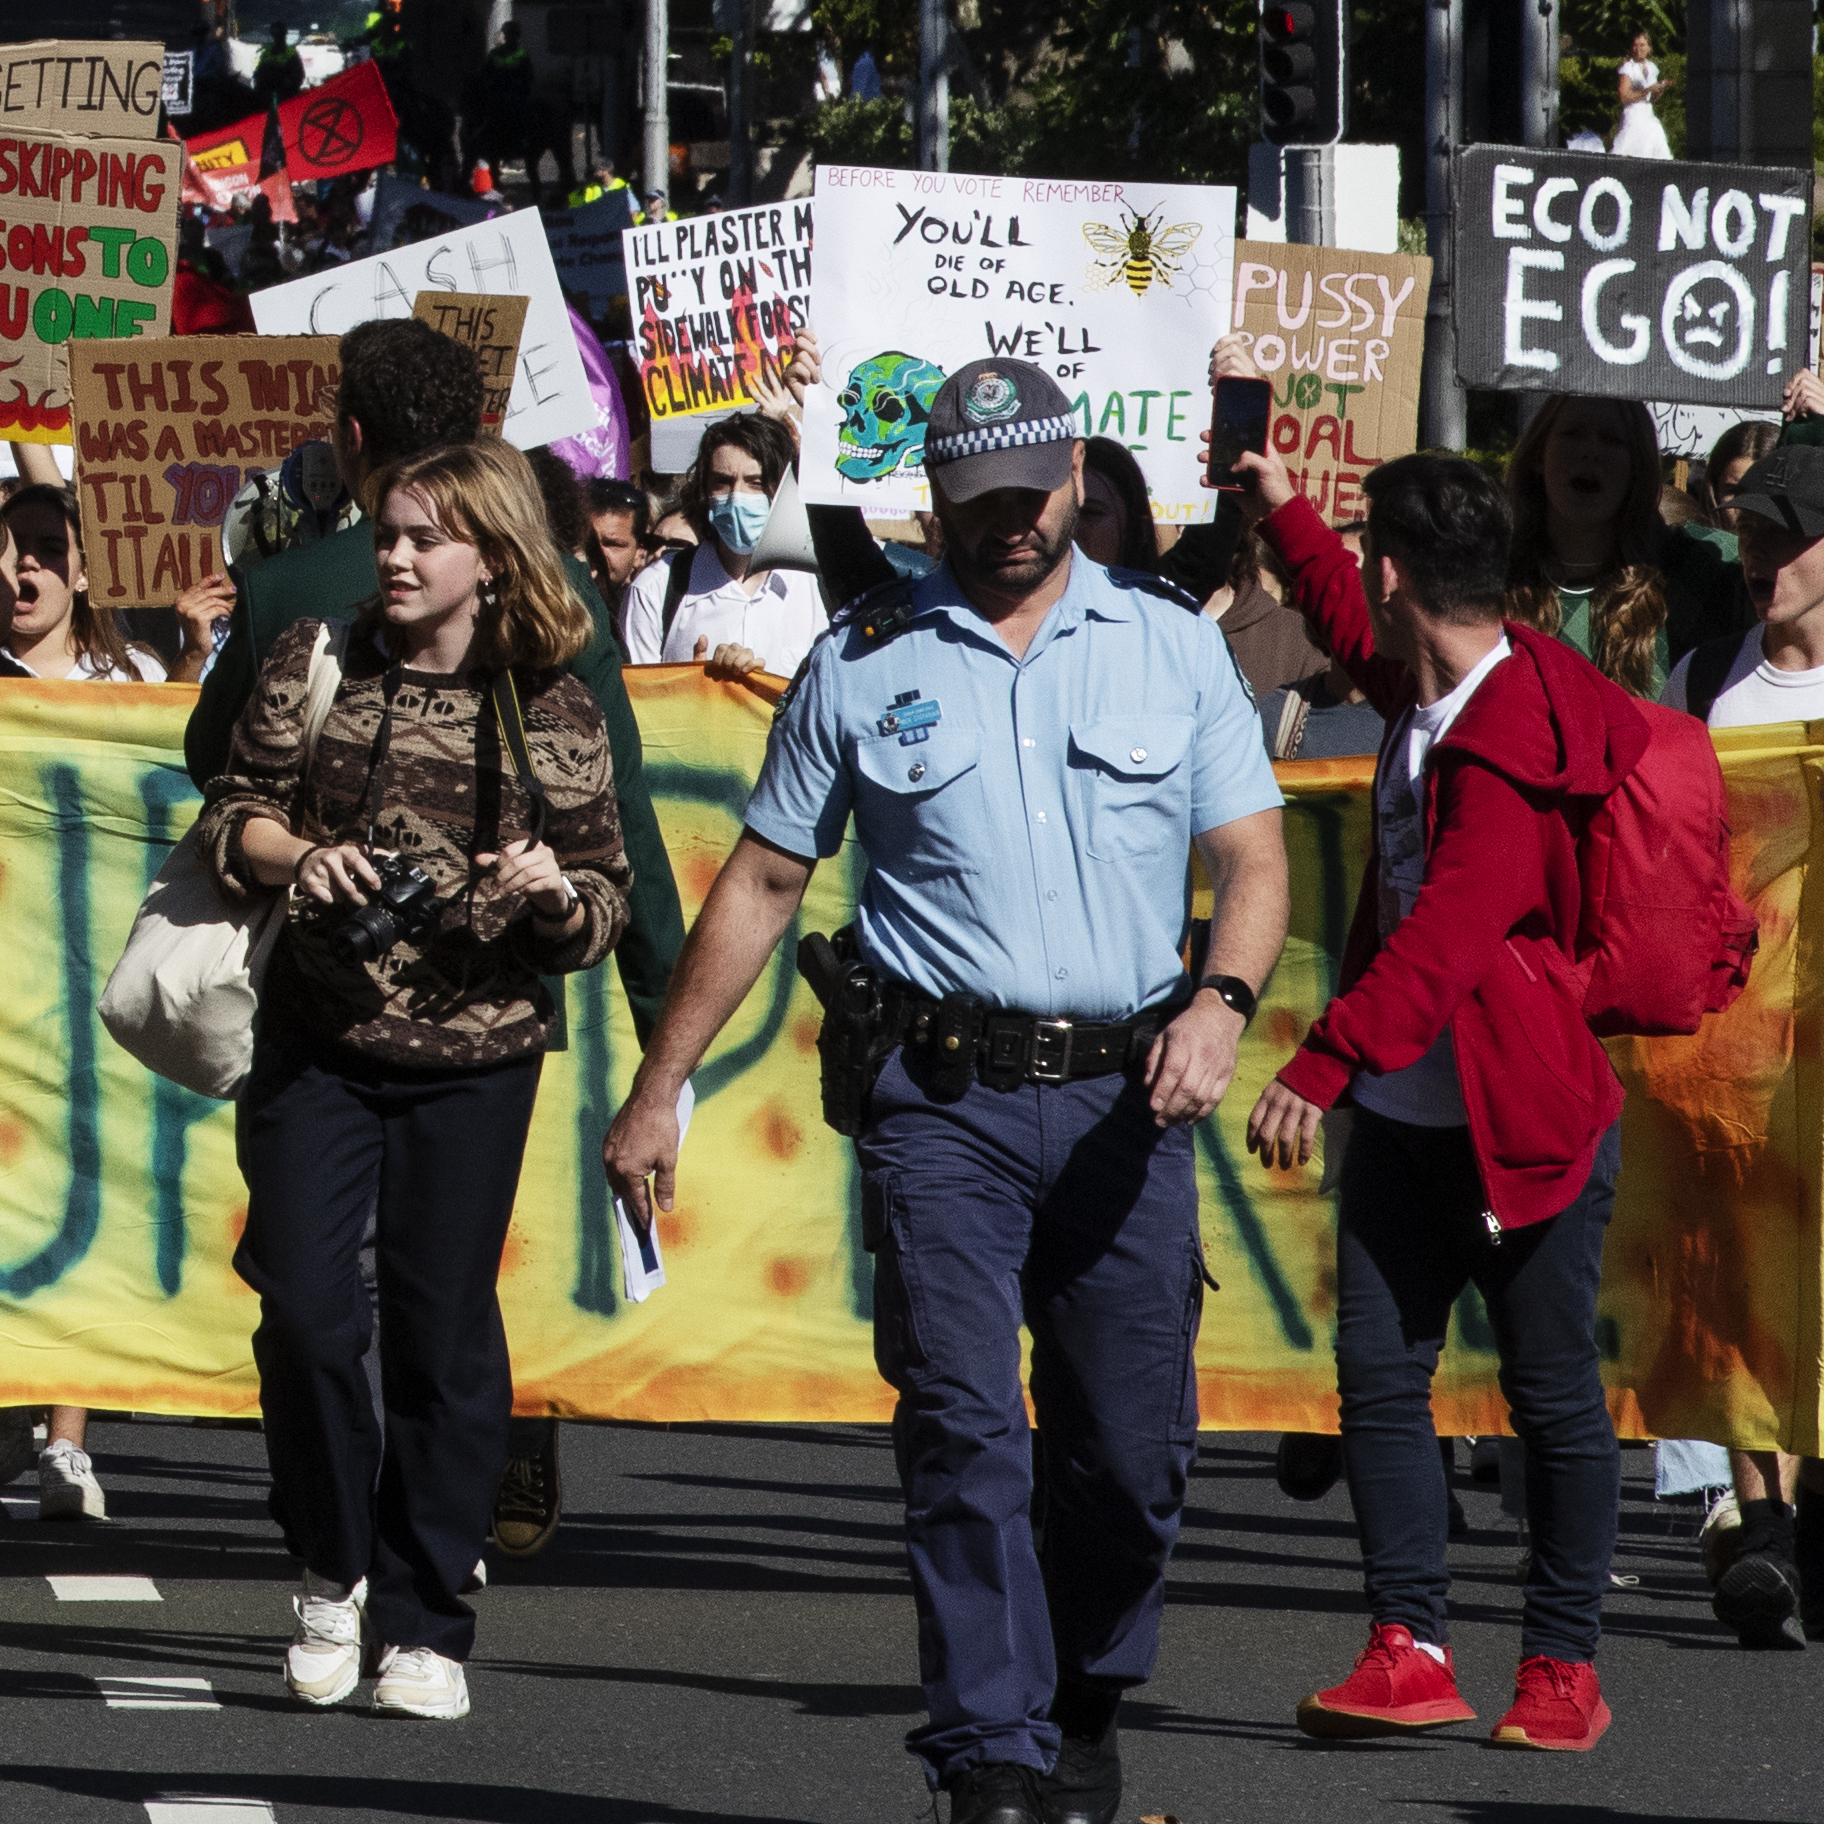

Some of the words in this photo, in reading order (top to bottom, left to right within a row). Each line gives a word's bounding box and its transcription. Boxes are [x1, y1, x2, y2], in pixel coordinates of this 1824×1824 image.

[826, 167, 896, 191] BEFORE
[910, 173, 947, 193] YOU
[952, 176, 1003, 199] VOTE
[1021, 180, 1125, 205] REMEMBER
[1491, 163, 1633, 253] ECO
[1657, 182, 1807, 263] NOT
[632, 230, 670, 268] I'LL
[675, 209, 786, 260] PLASTER
[892, 201, 1035, 249] YOU'LL
[87, 225, 169, 288] TO
[309, 232, 519, 335] CASH
[719, 256, 758, 301] ON
[934, 253, 966, 273] DIE
[979, 256, 1007, 275] OF
[32, 287, 157, 345] ONE
[927, 275, 989, 302] OLD
[1005, 280, 1077, 307] AGE.
[1233, 261, 1416, 338] PUSSY
[1502, 245, 1792, 381] EGO!
[432, 305, 498, 342] THIS
[638, 306, 745, 361] SIDEWALK
[745, 298, 792, 342] FOR
[984, 319, 1102, 358] WE'LL
[92, 359, 230, 416] THIS
[646, 352, 754, 417] CLIMATE
[1056, 363, 1086, 379] OF
[79, 419, 151, 463] WAS
[154, 425, 185, 461] A
[100, 526, 149, 600] IT
